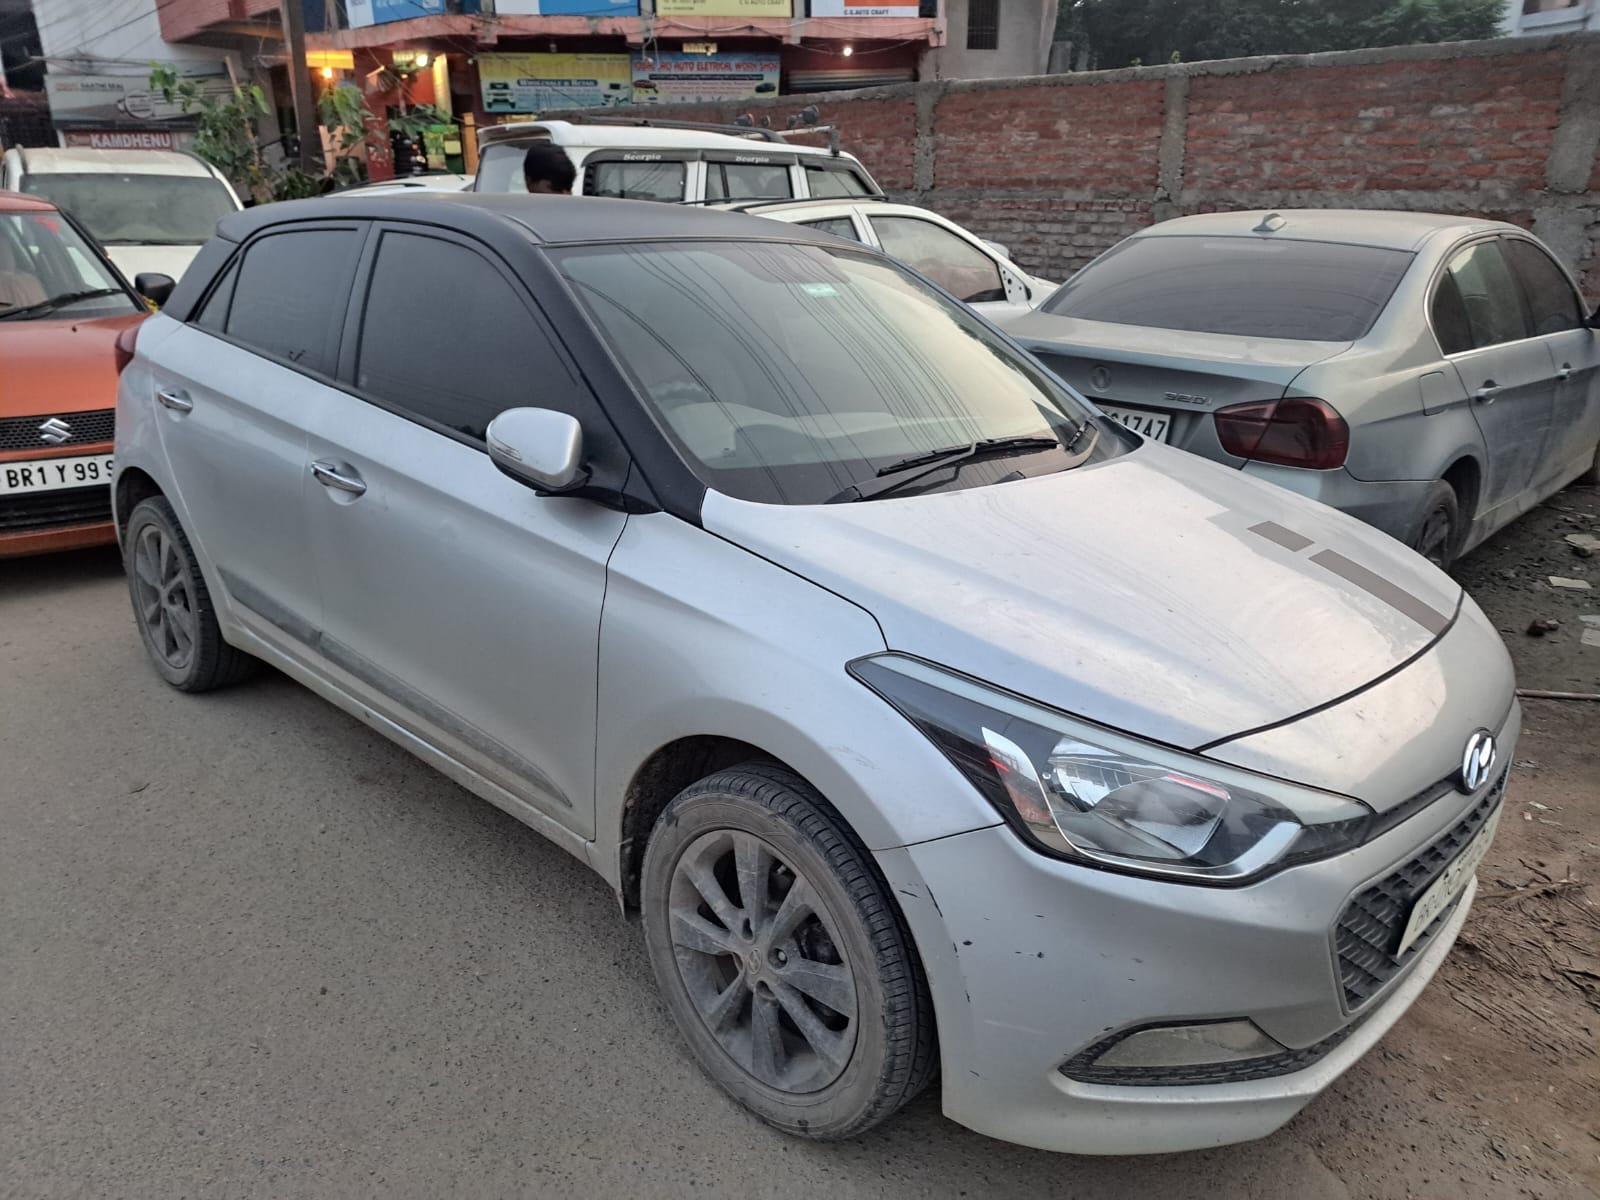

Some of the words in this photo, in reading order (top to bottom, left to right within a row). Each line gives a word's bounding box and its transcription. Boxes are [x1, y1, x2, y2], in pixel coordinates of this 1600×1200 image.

[90, 133, 171, 148] KAMDHENU
[623, 153, 661, 162] Scorpio
[736, 155, 770, 164] Scorpio
